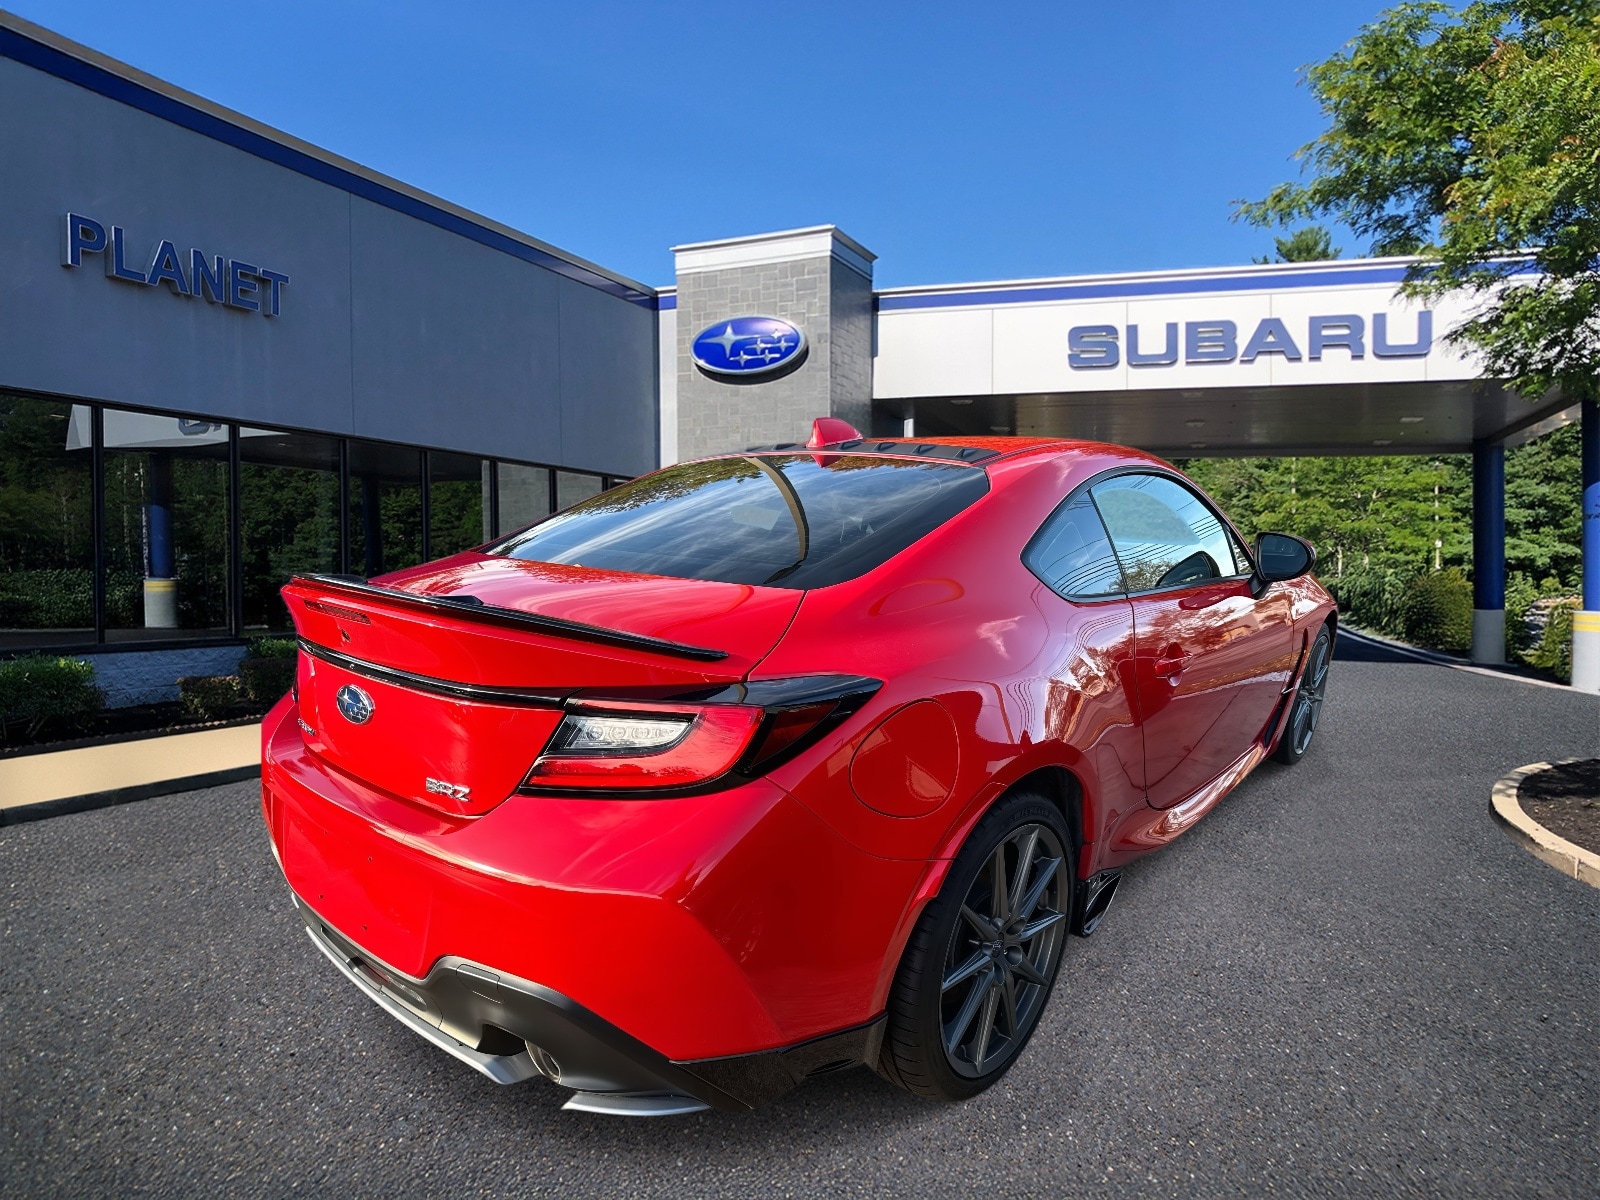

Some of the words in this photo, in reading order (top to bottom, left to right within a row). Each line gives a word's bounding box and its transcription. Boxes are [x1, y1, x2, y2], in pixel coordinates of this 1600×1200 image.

[60, 211, 291, 318] PLANET
[1067, 309, 1433, 370] SUBARU
[425, 776, 471, 802] BRZ
